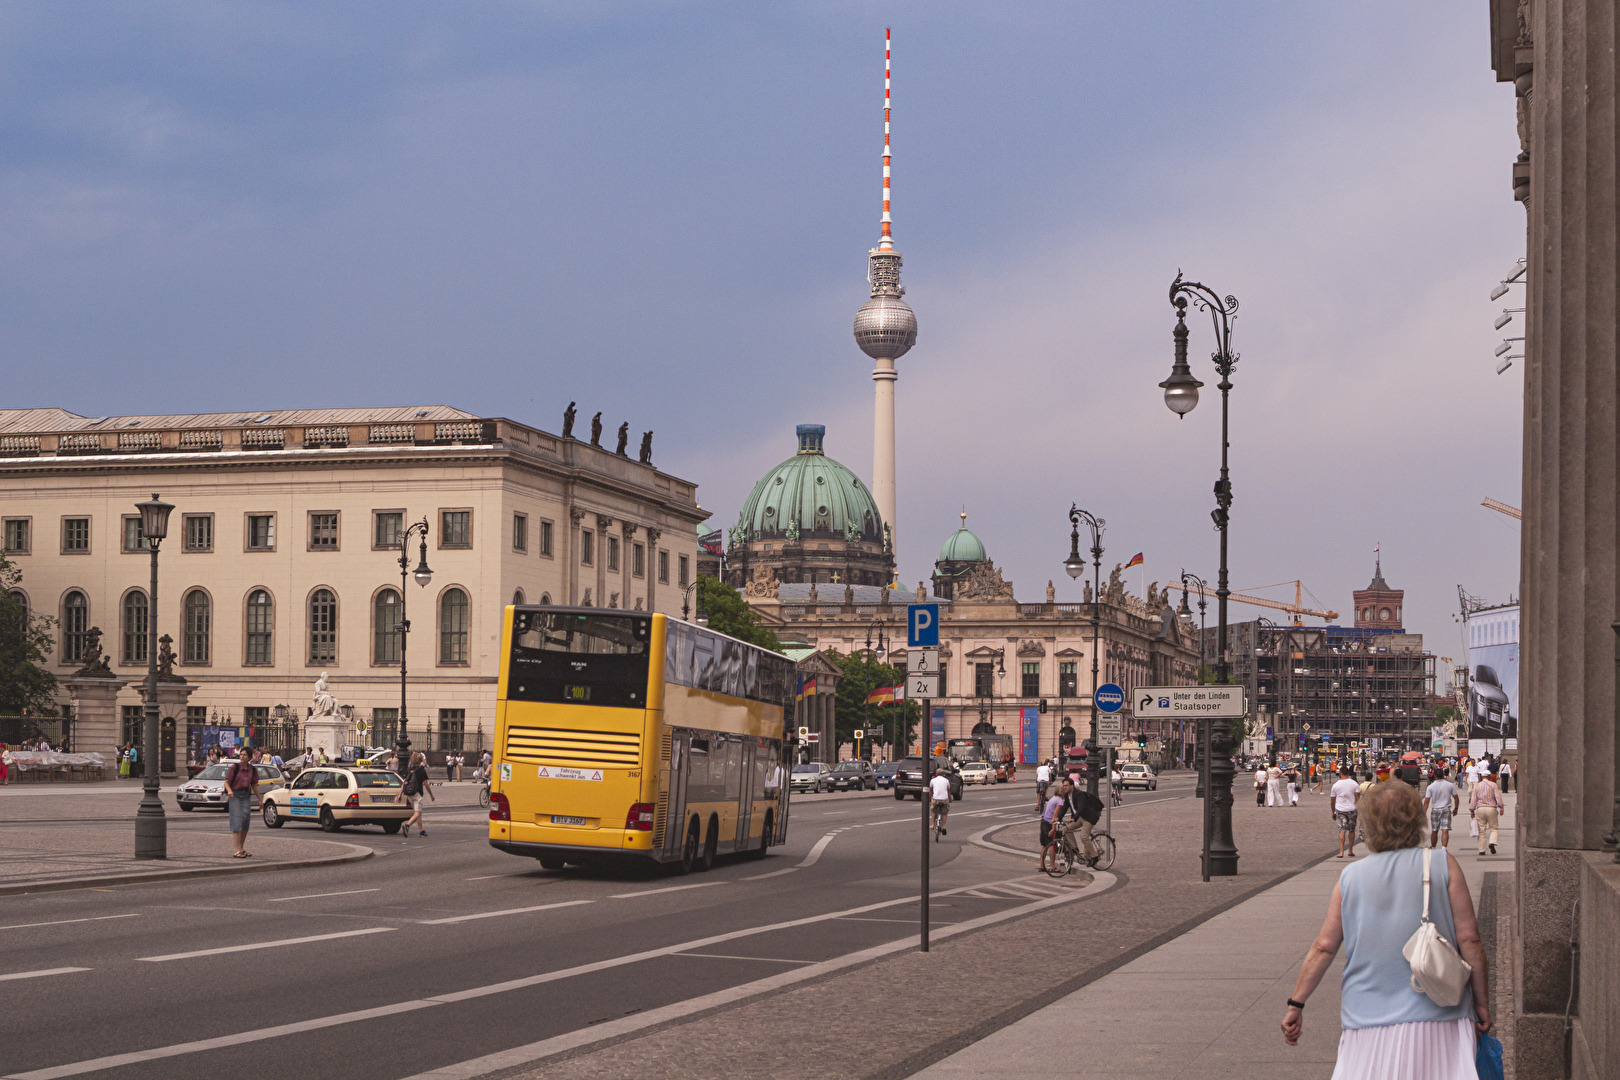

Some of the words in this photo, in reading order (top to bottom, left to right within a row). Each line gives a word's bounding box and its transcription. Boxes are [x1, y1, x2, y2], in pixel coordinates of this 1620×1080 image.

[914, 609, 932, 642] P
[572, 687, 584, 698] 100
[916, 681, 928, 693] 2x
[1173, 692, 1191, 700] Unter
[1193, 692, 1206, 700] den
[1208, 692, 1230, 700] Linden
[1174, 702, 1221, 712] Staatsoper
